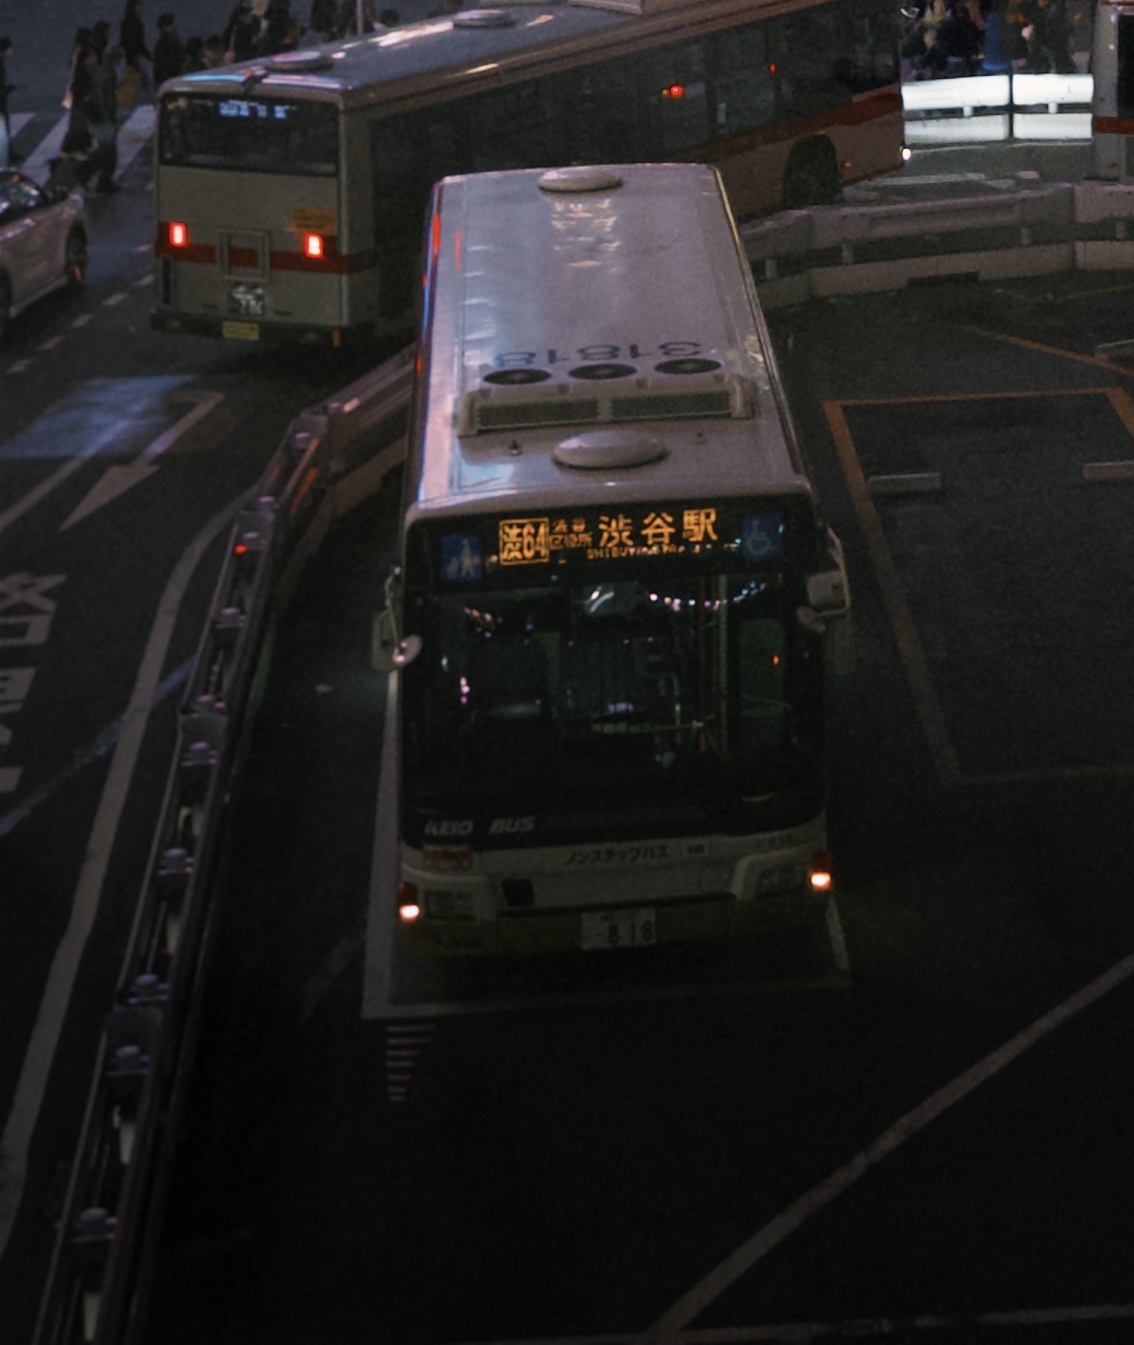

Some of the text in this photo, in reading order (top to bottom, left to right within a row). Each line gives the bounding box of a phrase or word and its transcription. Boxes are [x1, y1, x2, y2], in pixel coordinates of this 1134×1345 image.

[501, 507, 719, 565] 渋64 渋谷駅
[424, 815, 537, 837] KEIO BUS
